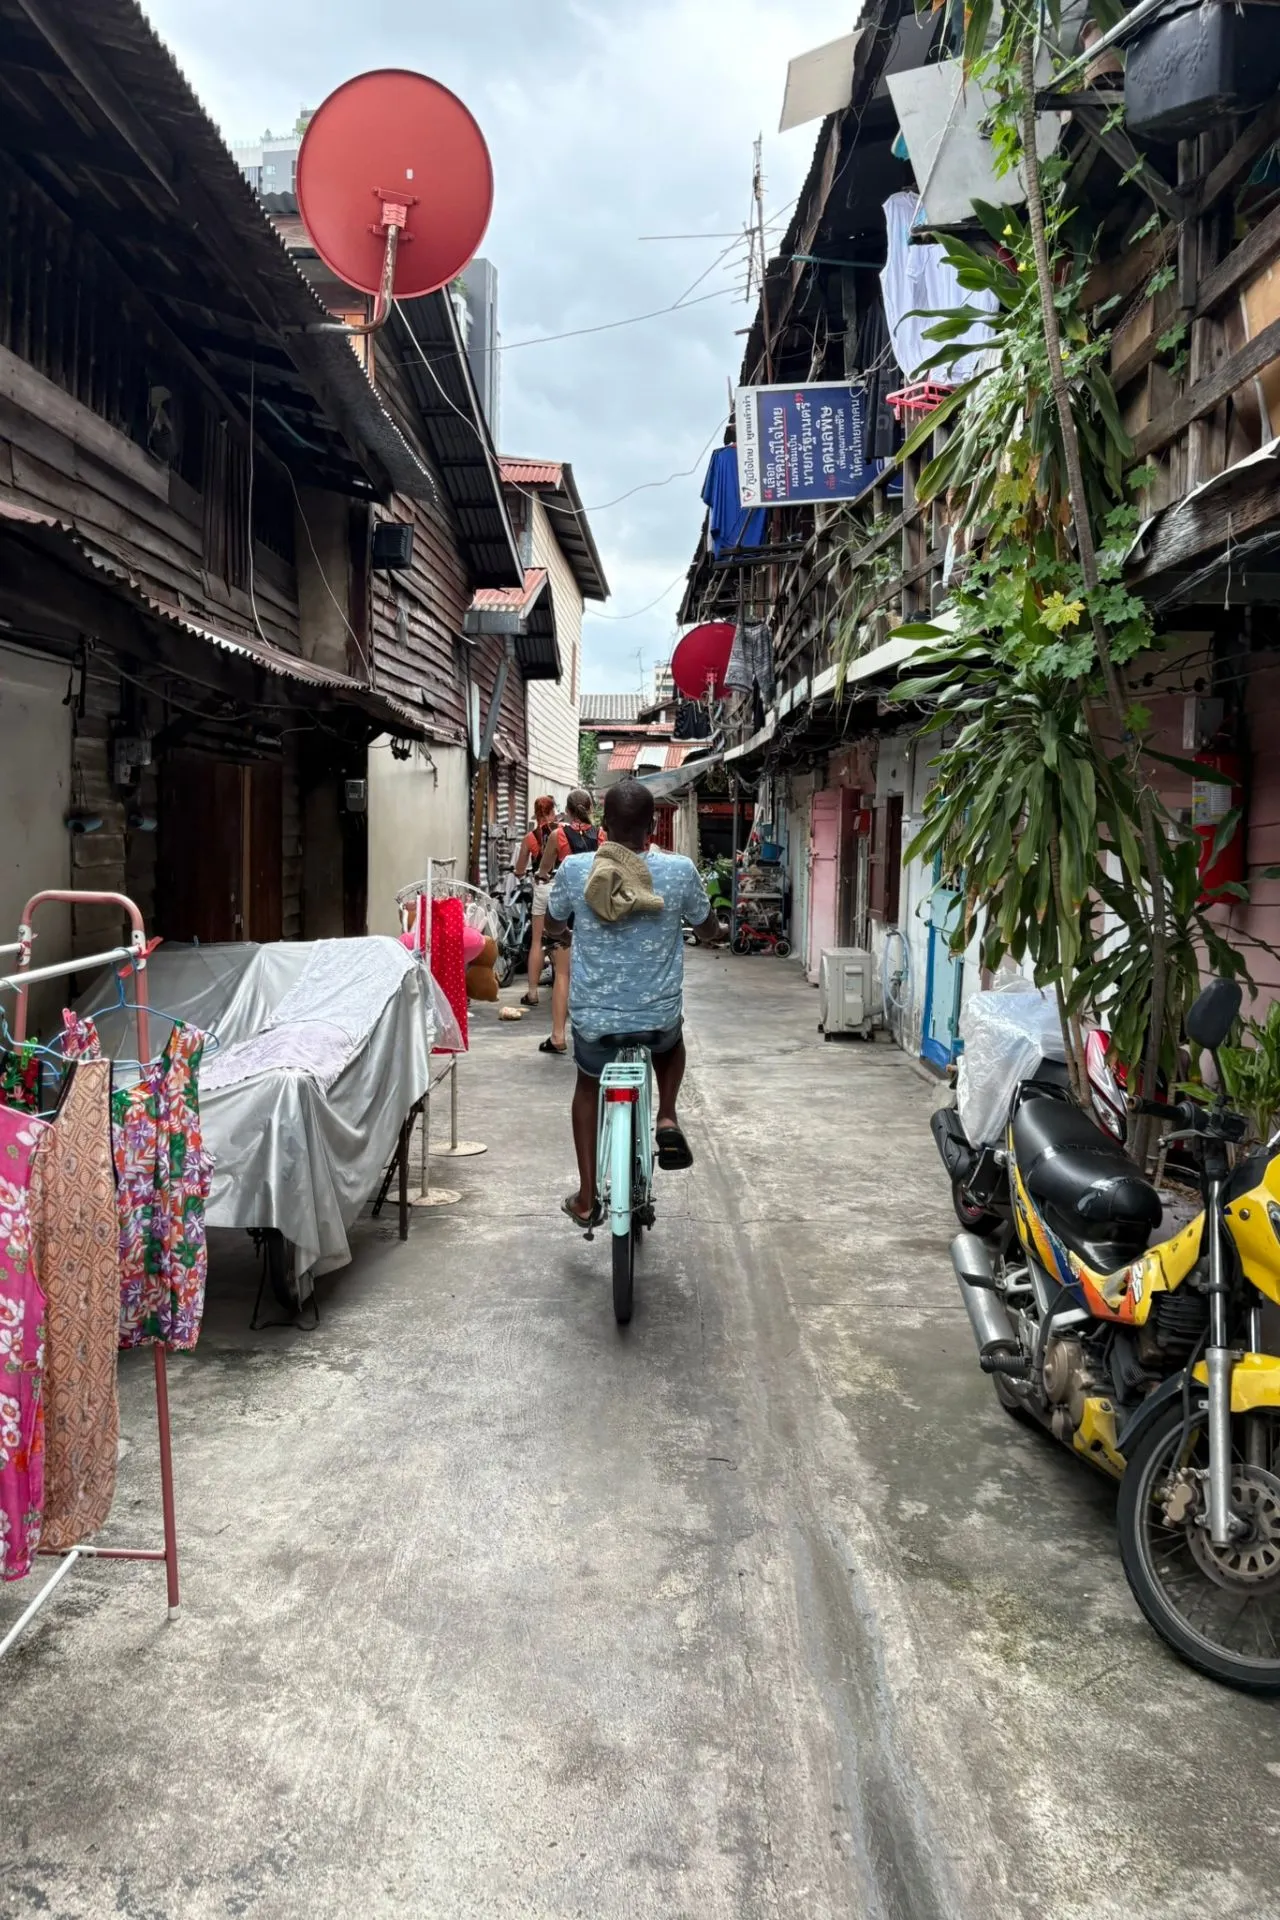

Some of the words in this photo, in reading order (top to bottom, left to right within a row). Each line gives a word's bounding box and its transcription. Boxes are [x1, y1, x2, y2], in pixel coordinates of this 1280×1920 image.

[769, 408, 789, 498] พรรคภูมิใจไทย
